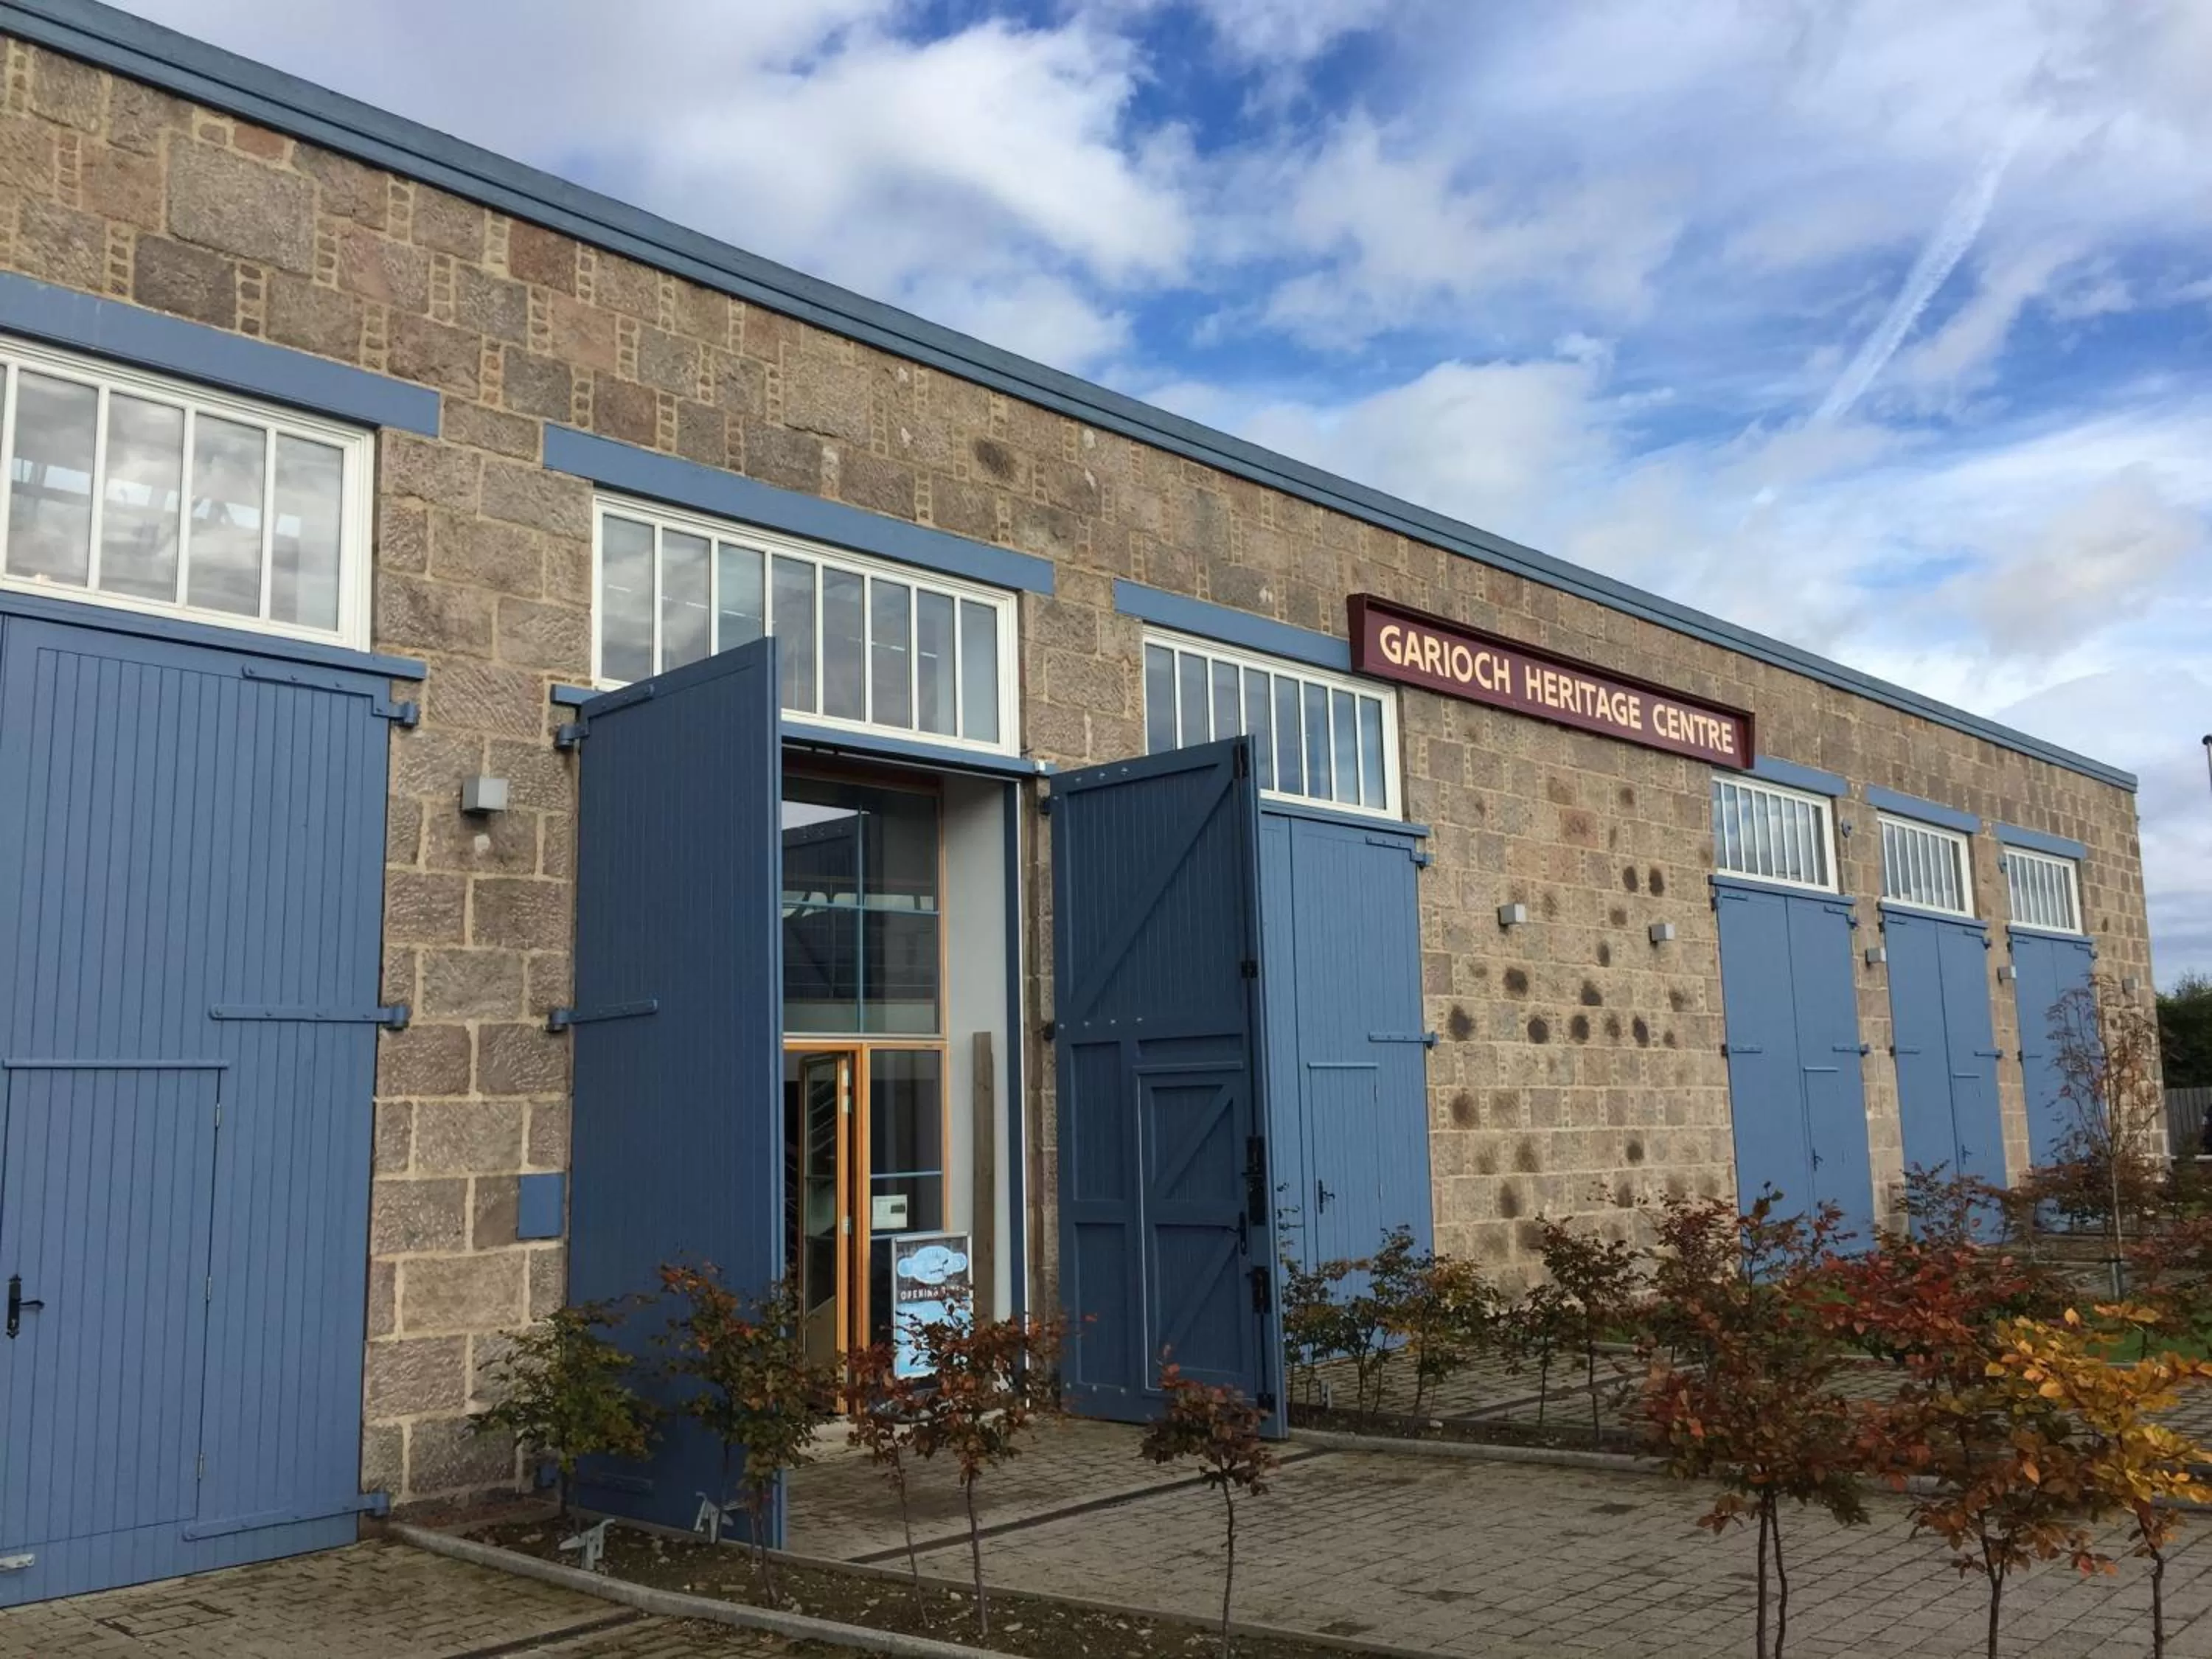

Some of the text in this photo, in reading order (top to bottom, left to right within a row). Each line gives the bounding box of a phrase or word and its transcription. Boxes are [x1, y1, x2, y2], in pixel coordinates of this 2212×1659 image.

[1380, 625, 1734, 754] GARIOCH HERITAGE CENTRE
